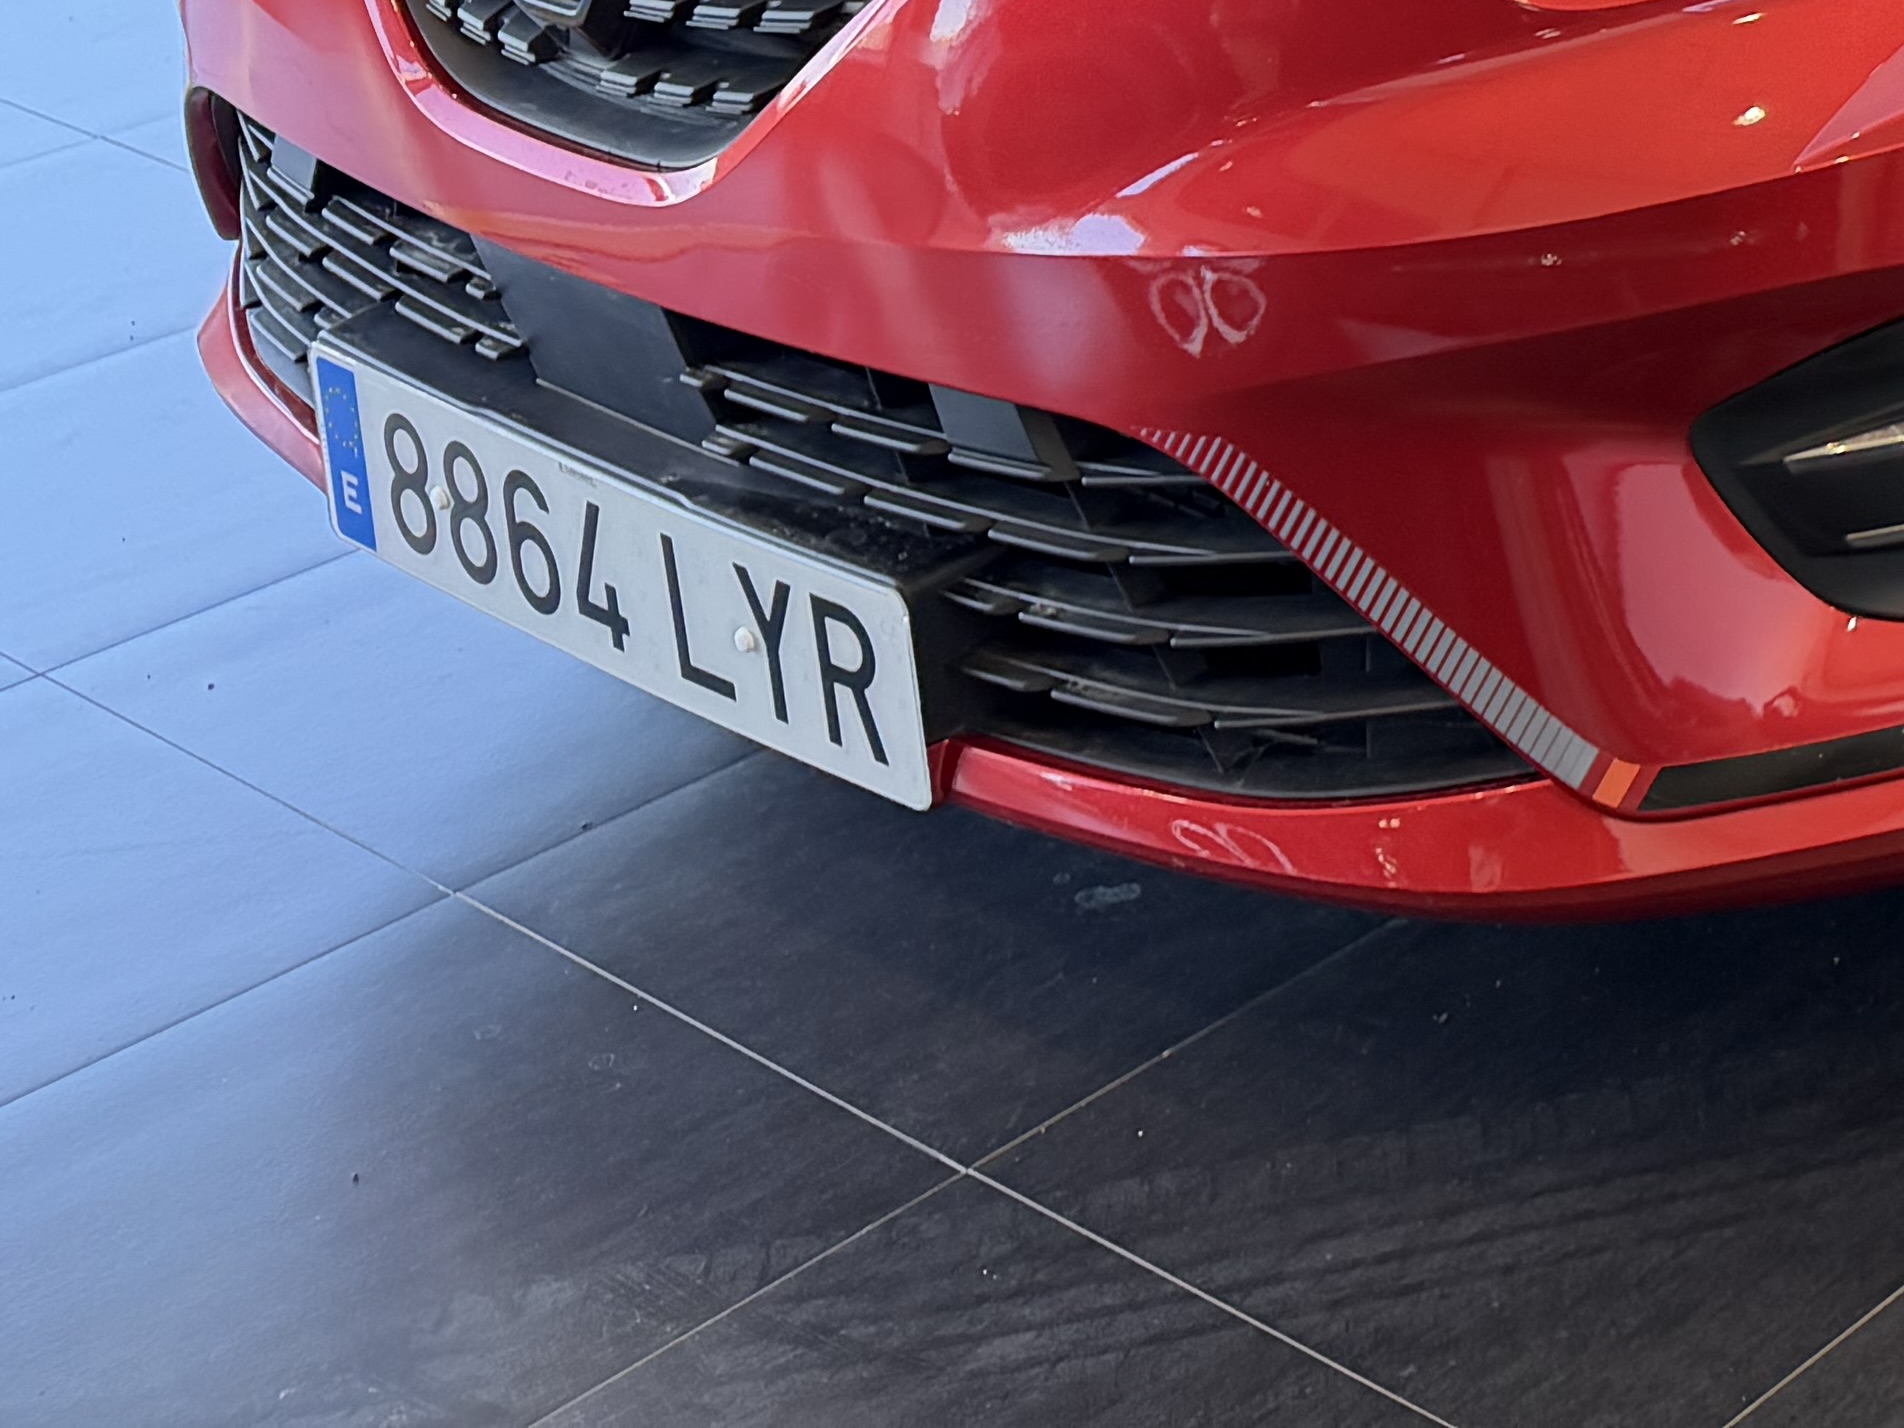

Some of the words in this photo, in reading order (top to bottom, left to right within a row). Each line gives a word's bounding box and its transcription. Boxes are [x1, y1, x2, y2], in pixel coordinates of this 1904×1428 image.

[340, 469, 363, 516] E
[383, 411, 631, 653] 8864
[659, 532, 890, 767] LYR
